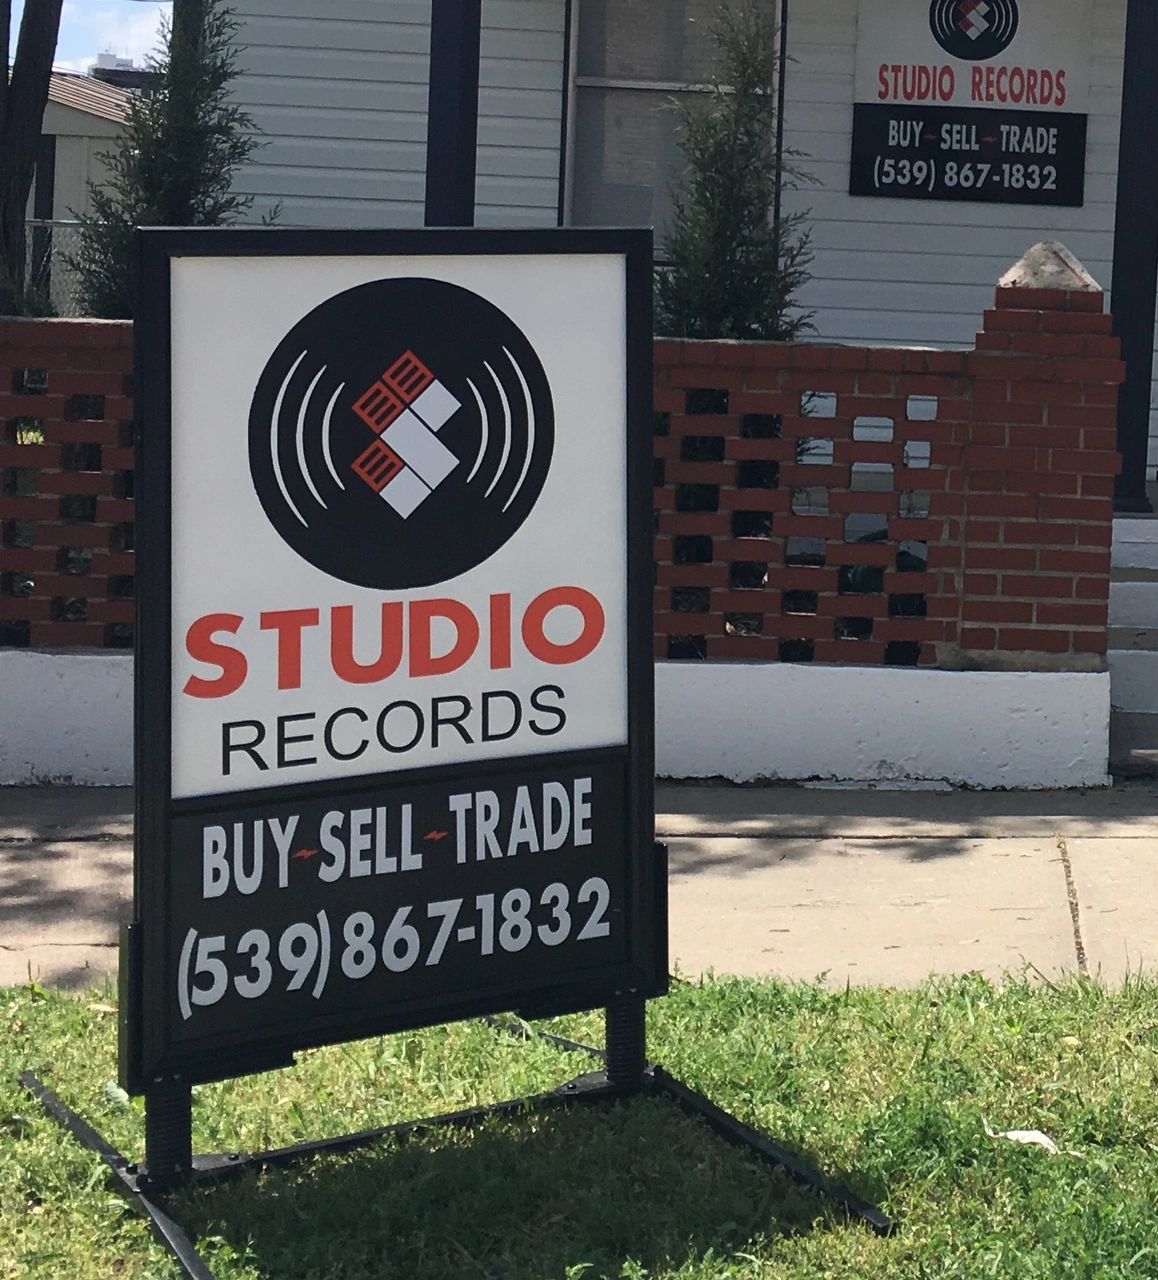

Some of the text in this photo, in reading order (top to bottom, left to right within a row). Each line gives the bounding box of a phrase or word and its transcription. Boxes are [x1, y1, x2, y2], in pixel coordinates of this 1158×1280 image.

[878, 64, 1066, 106] STUDIO RECORDS
[888, 120, 1058, 155] BUY SELL TRADE
[874, 155, 1057, 192] (539) 867-1832
[183, 586, 605, 699] STUDIO
[221, 684, 567, 775] RECORDS
[203, 777, 592, 899] BUY SELL TRADE
